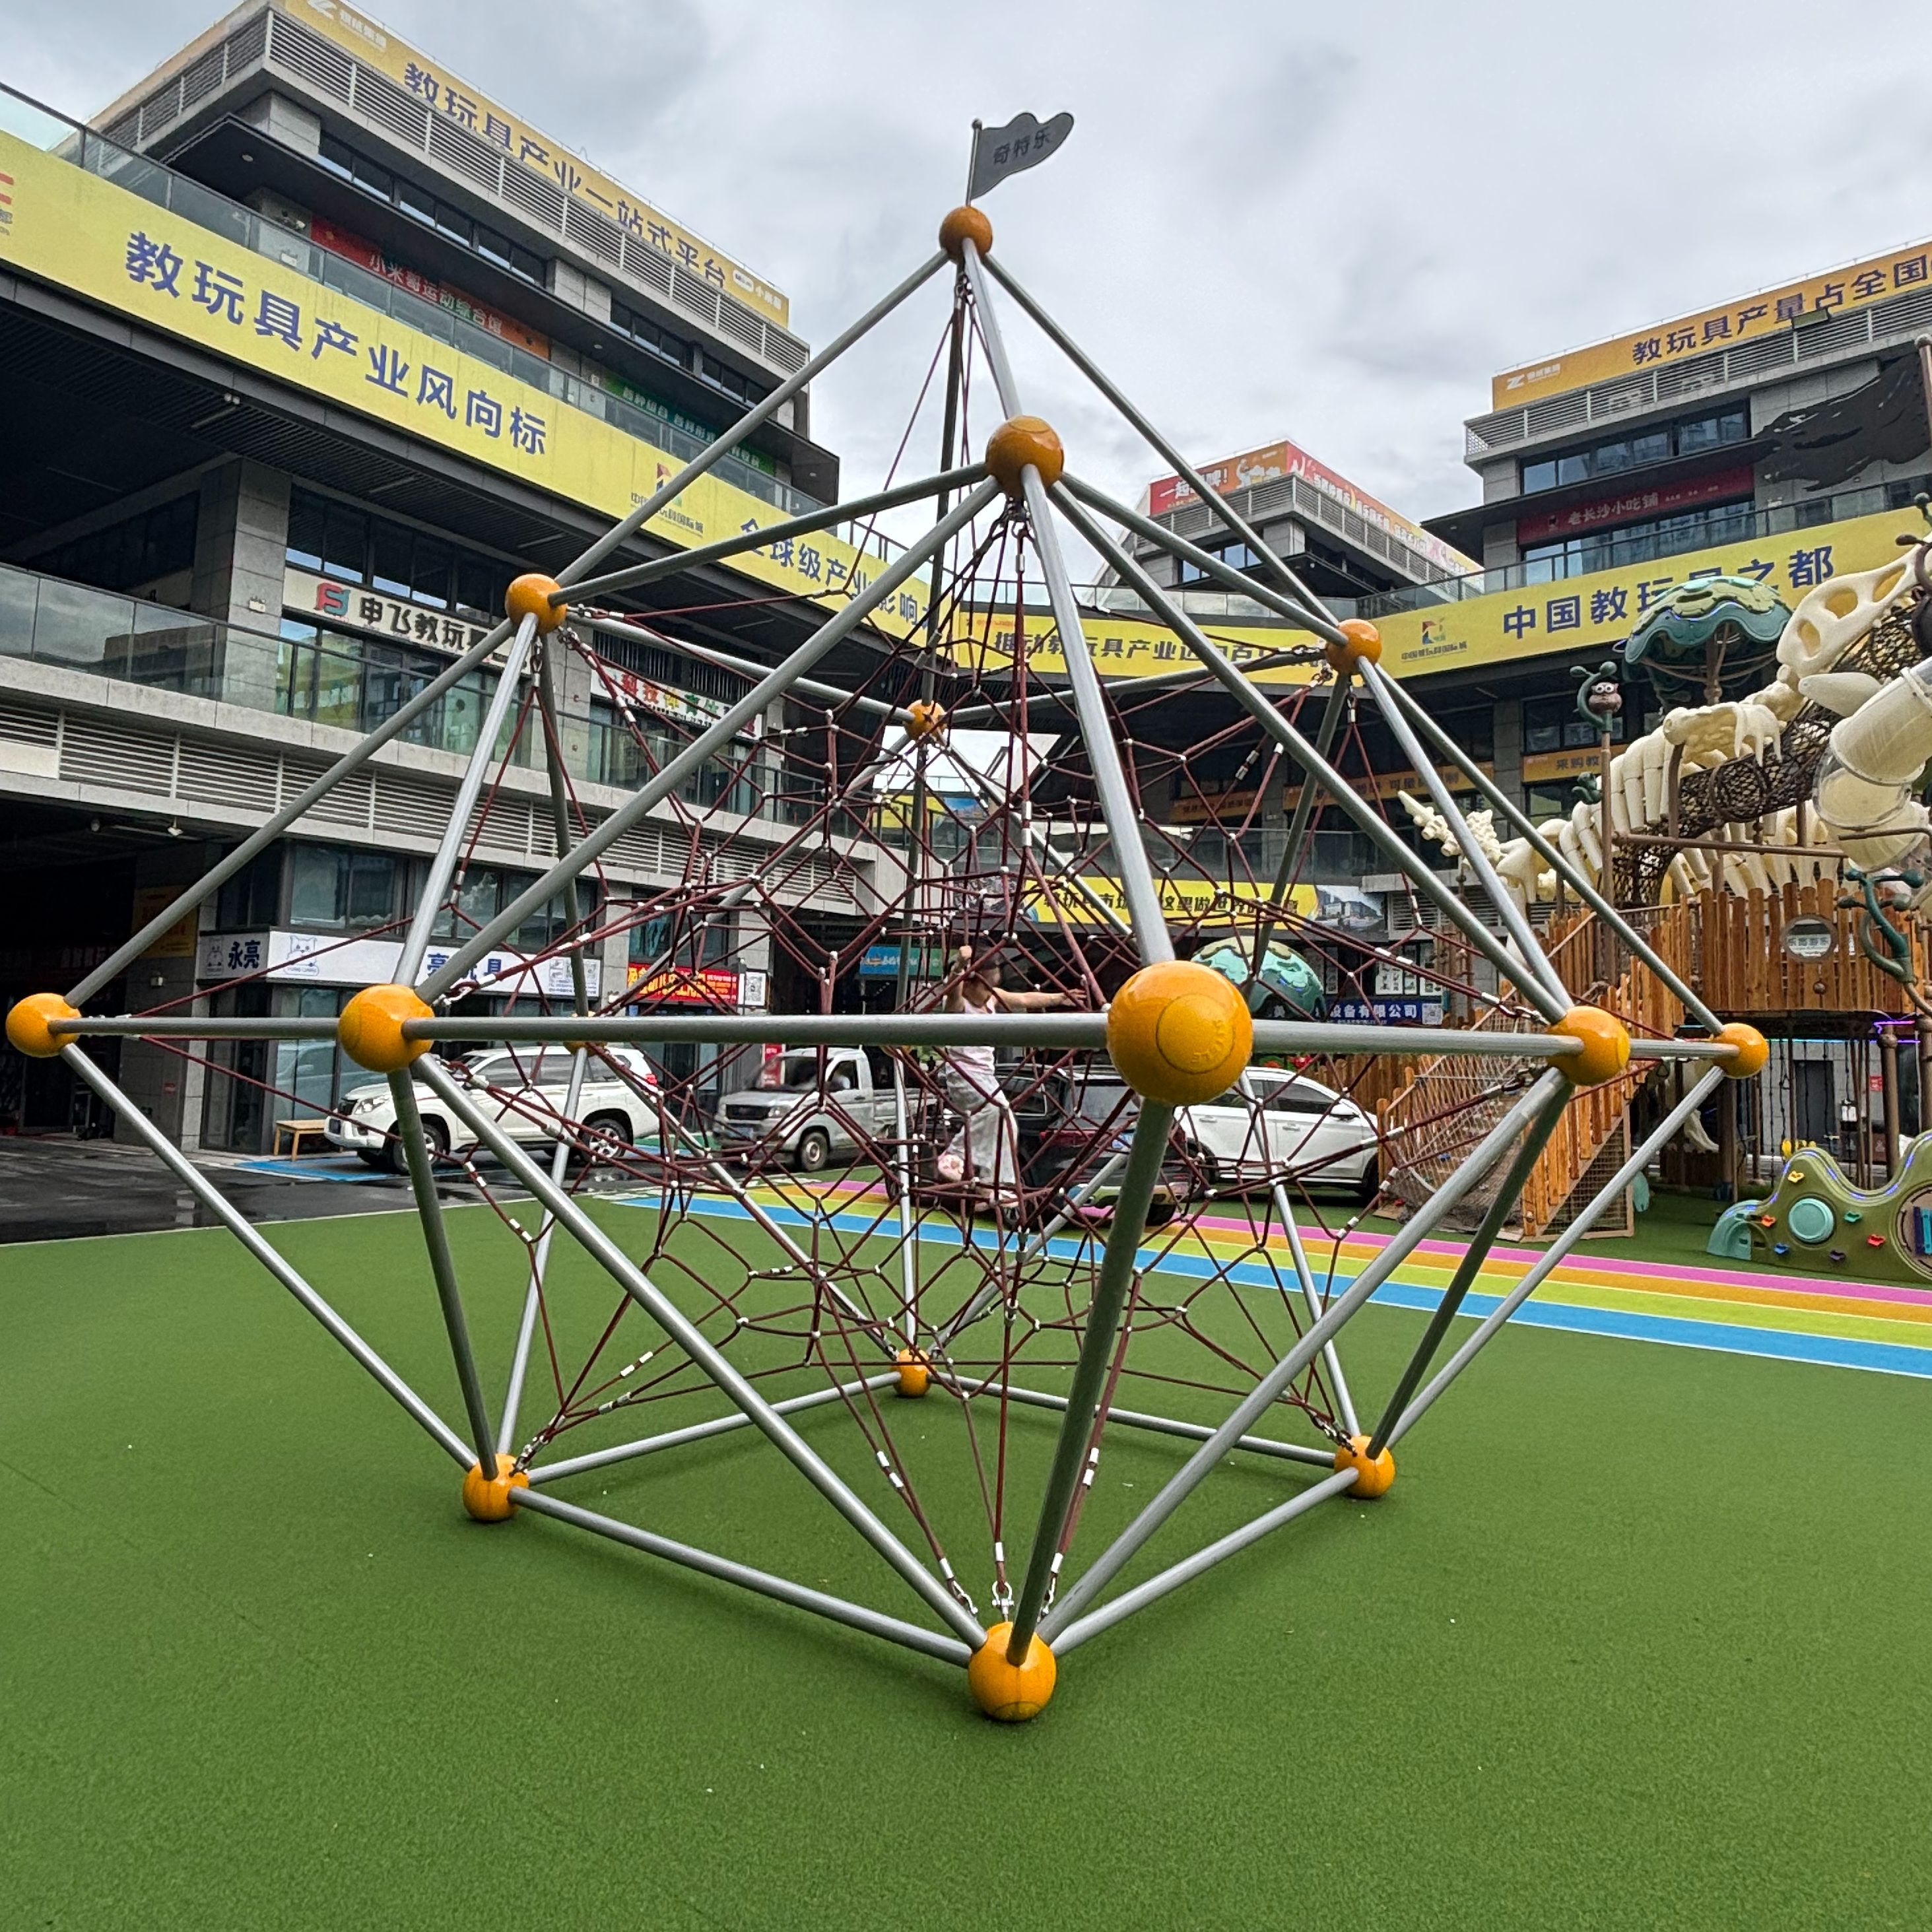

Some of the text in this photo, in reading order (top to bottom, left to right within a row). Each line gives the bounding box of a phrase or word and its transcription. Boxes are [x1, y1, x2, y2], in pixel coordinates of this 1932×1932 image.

[404, 62, 726, 289] 教玩具产业一站式平台
[993, 126, 1051, 165] 奇特乐
[125, 231, 547, 455] 教玩具产业风向标
[1503, 545, 1834, 639] 中国教玩之都
[228, 939, 261, 970] 永亮
